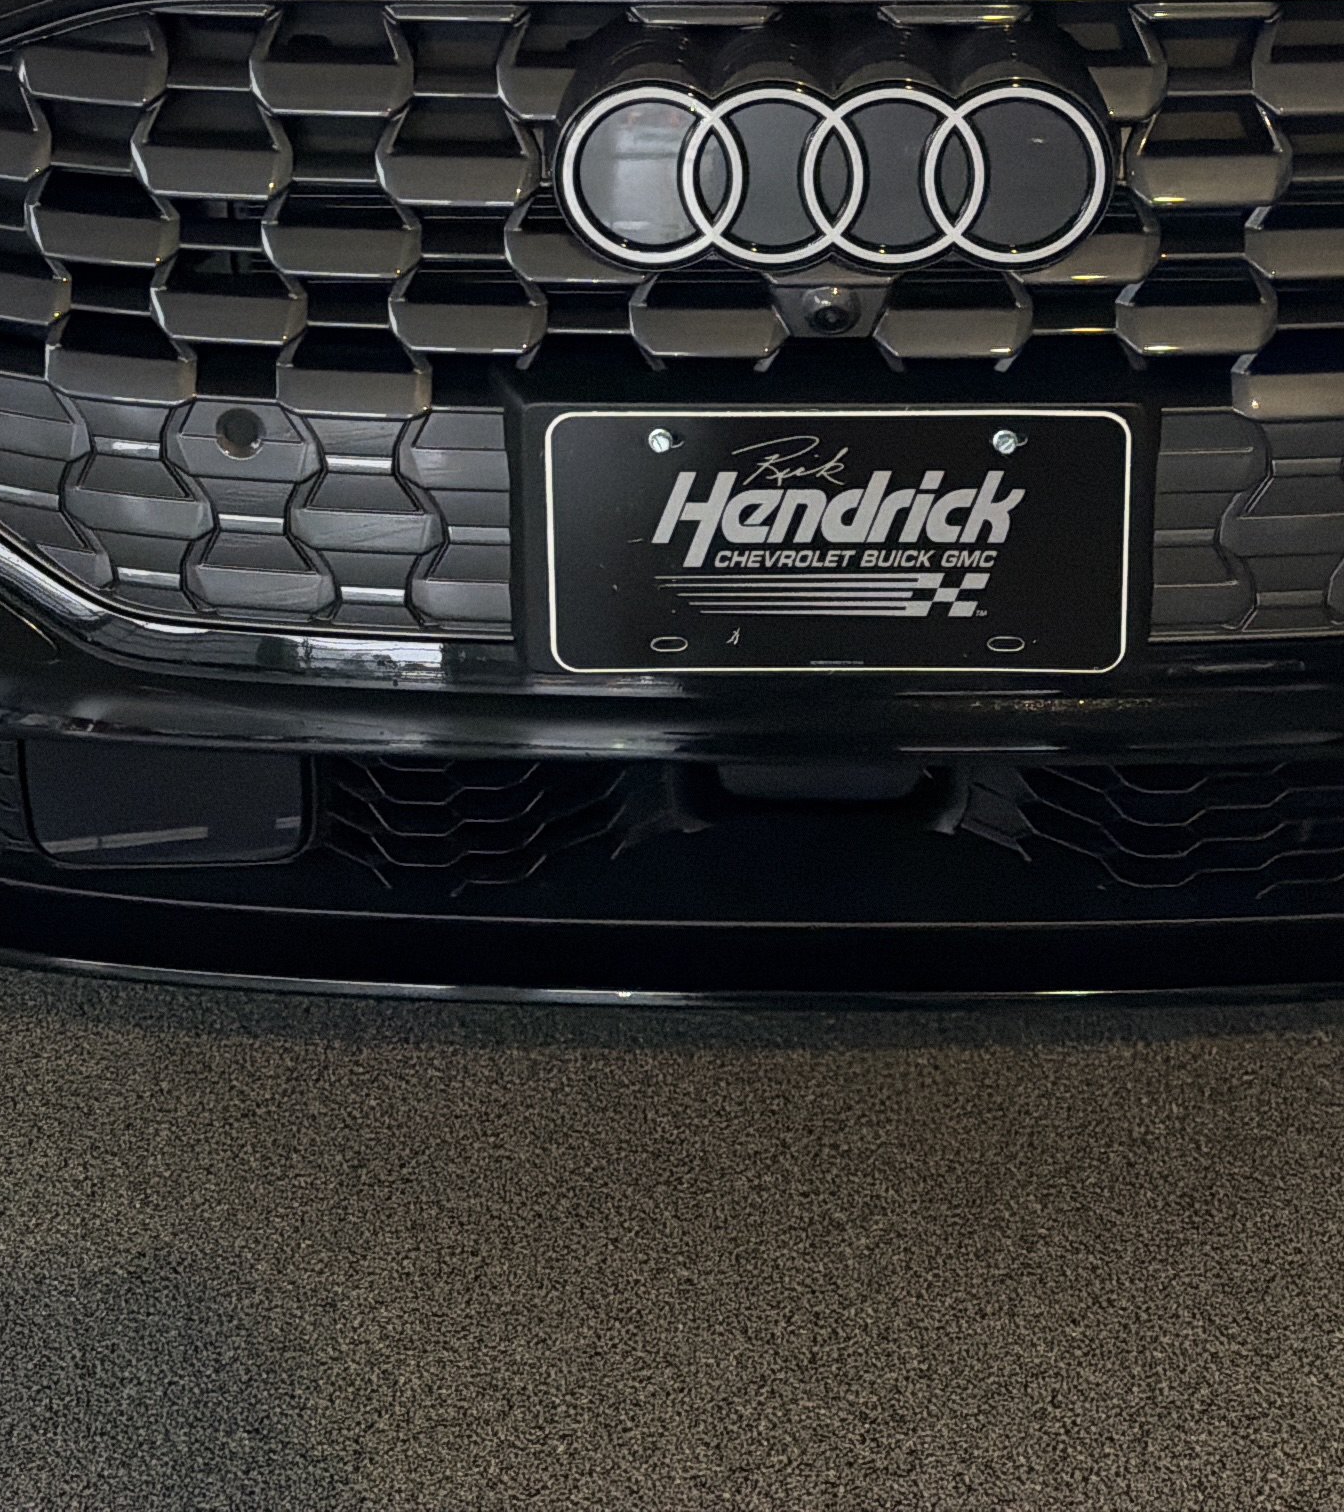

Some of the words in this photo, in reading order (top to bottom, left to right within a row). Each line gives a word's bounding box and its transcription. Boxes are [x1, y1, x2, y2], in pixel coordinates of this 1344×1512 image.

[652, 470, 1026, 568] Hendrick
[714, 550, 856, 569] CHEVROLET
[860, 550, 935, 569] BUICK
[940, 550, 998, 569] GMC
